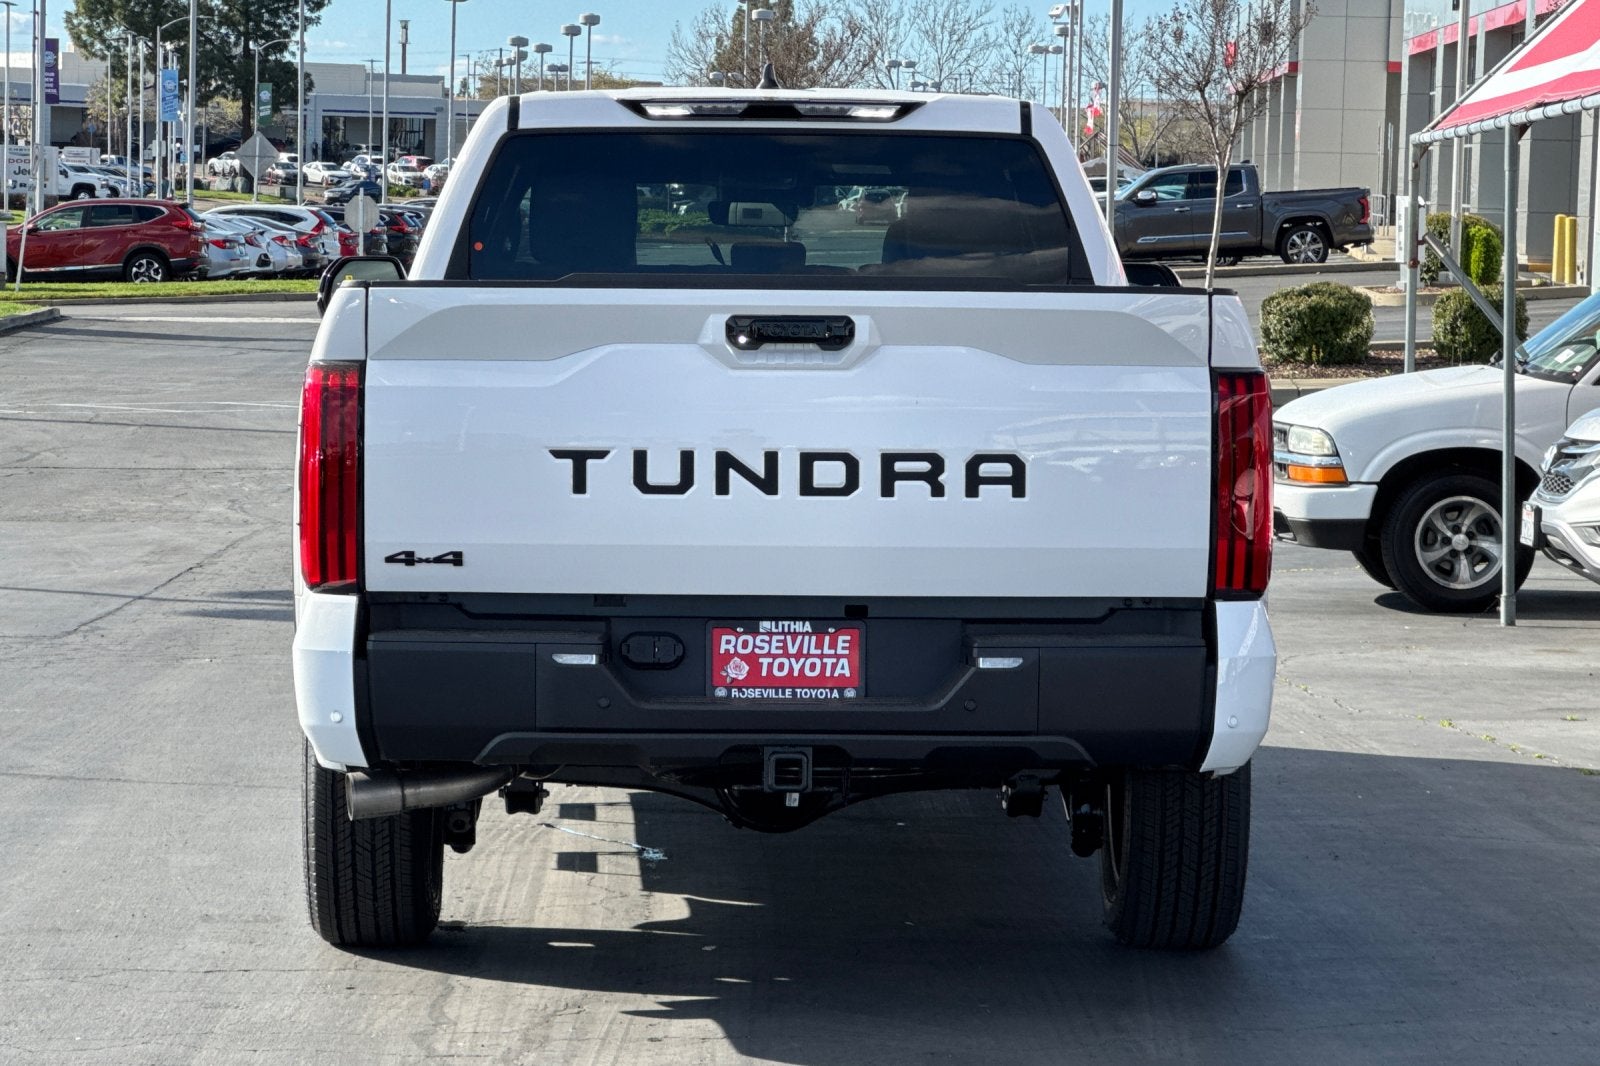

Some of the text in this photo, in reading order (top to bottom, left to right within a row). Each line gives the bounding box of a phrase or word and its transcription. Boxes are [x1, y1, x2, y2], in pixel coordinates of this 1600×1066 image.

[760, 322, 819, 336] TOYOTA
[548, 449, 1026, 499] TUNDRA
[771, 621, 813, 633] LITHIA
[719, 635, 852, 655] ROSEVILLE
[758, 657, 851, 678] TOYOTA
[731, 688, 840, 699] ROSEVILLE TOYOTA
